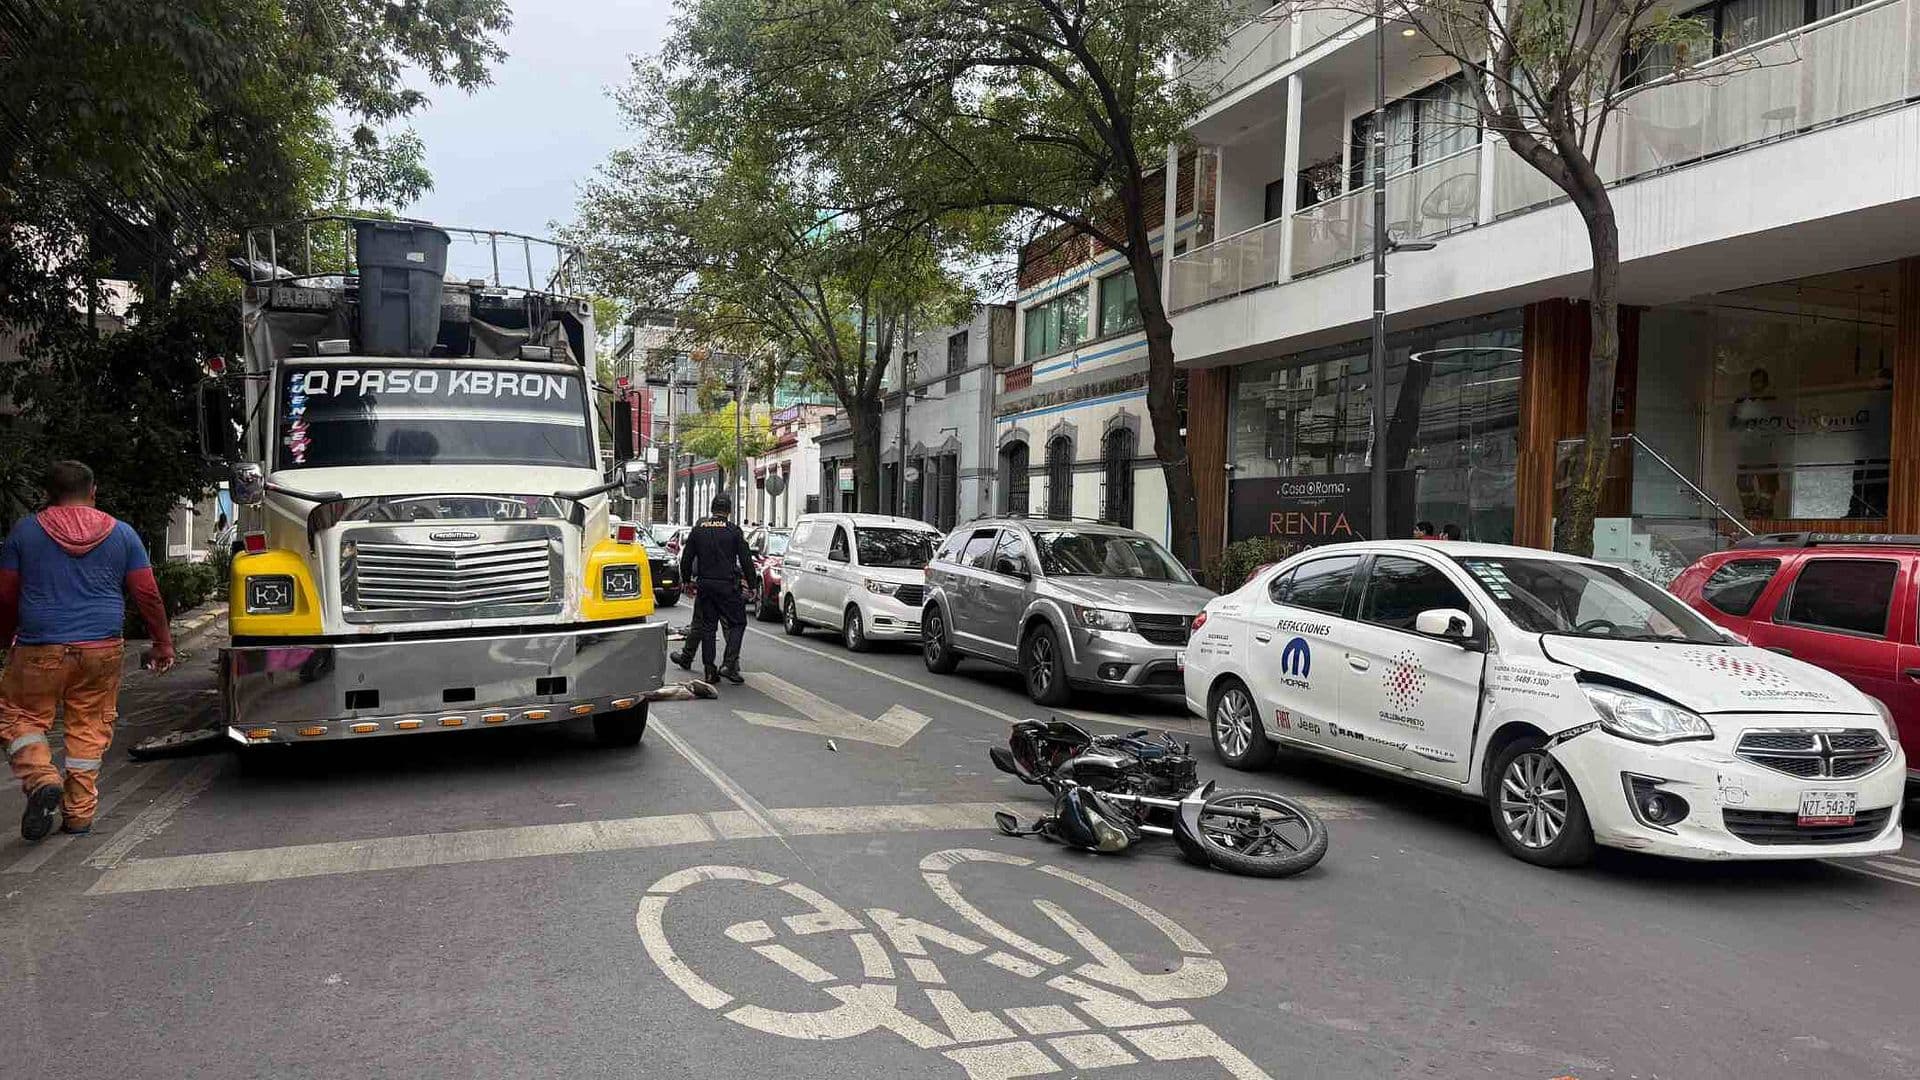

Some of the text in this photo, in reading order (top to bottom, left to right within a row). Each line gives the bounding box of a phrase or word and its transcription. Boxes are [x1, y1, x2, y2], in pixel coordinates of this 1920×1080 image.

[303, 370, 568, 400] Q PASO KBRON
[1281, 481, 1345, 496] Casa Roma
[1269, 511, 1353, 537] RENTA
[1815, 533, 1894, 543] DUSTER
[1277, 619, 1332, 637] REFACCIONES
[1280, 677, 1310, 690] MOPAR
[1297, 716, 1321, 736] Jeep
[1339, 728, 1364, 741] RAM
[1802, 800, 1856, 815] NZT-543-B
